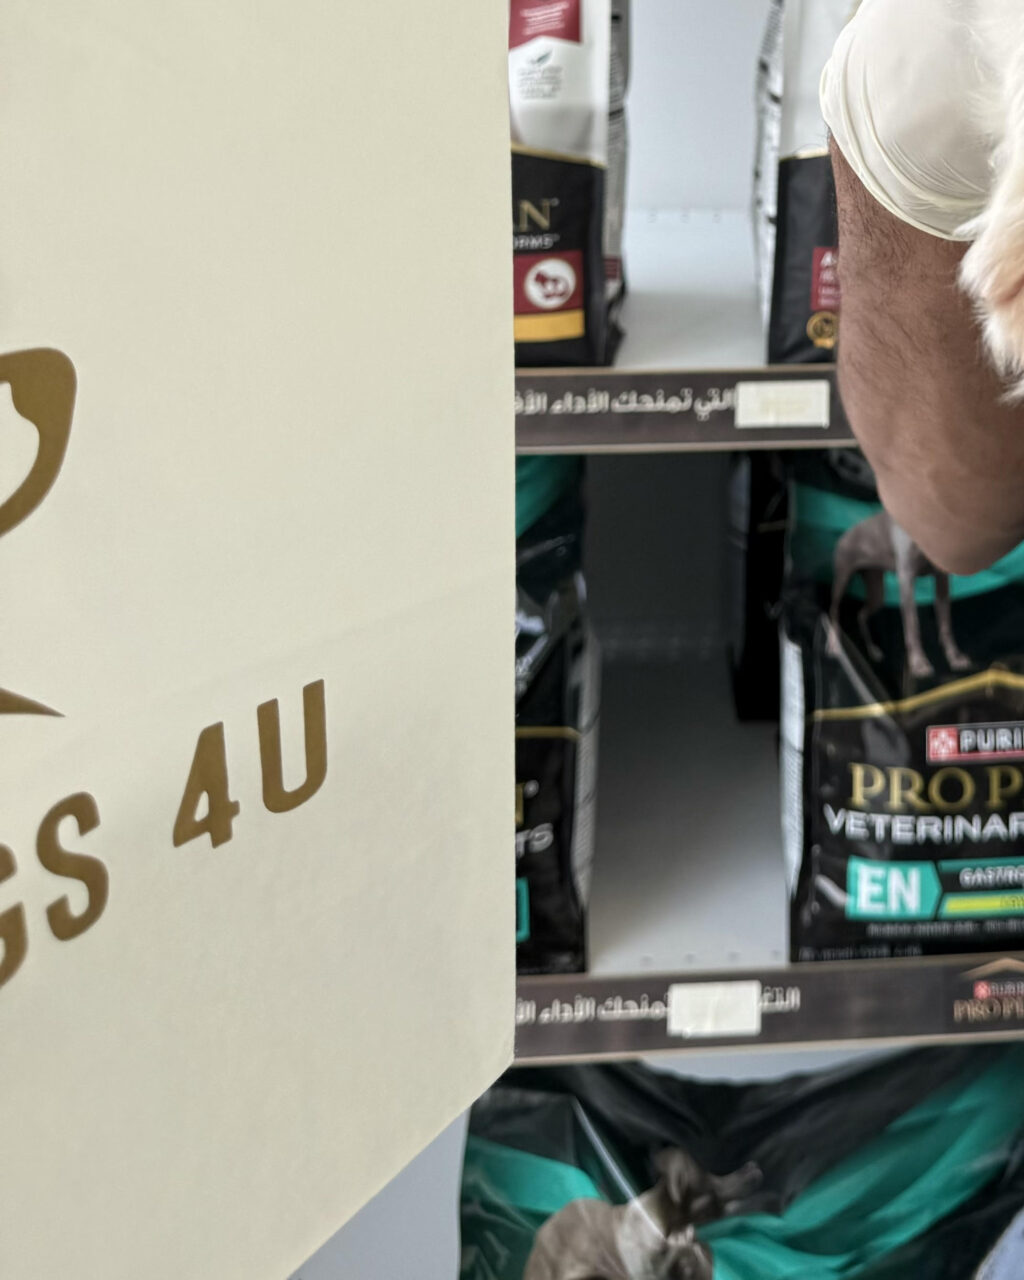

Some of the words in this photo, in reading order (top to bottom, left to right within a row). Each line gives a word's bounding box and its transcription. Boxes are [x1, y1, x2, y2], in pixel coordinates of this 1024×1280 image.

[550, 388, 609, 414] الأداء
[611, 388, 692, 414] تمنحك
[173, 679, 328, 849] 4U
[849, 763, 976, 812] PRO
[856, 865, 922, 915] EN
